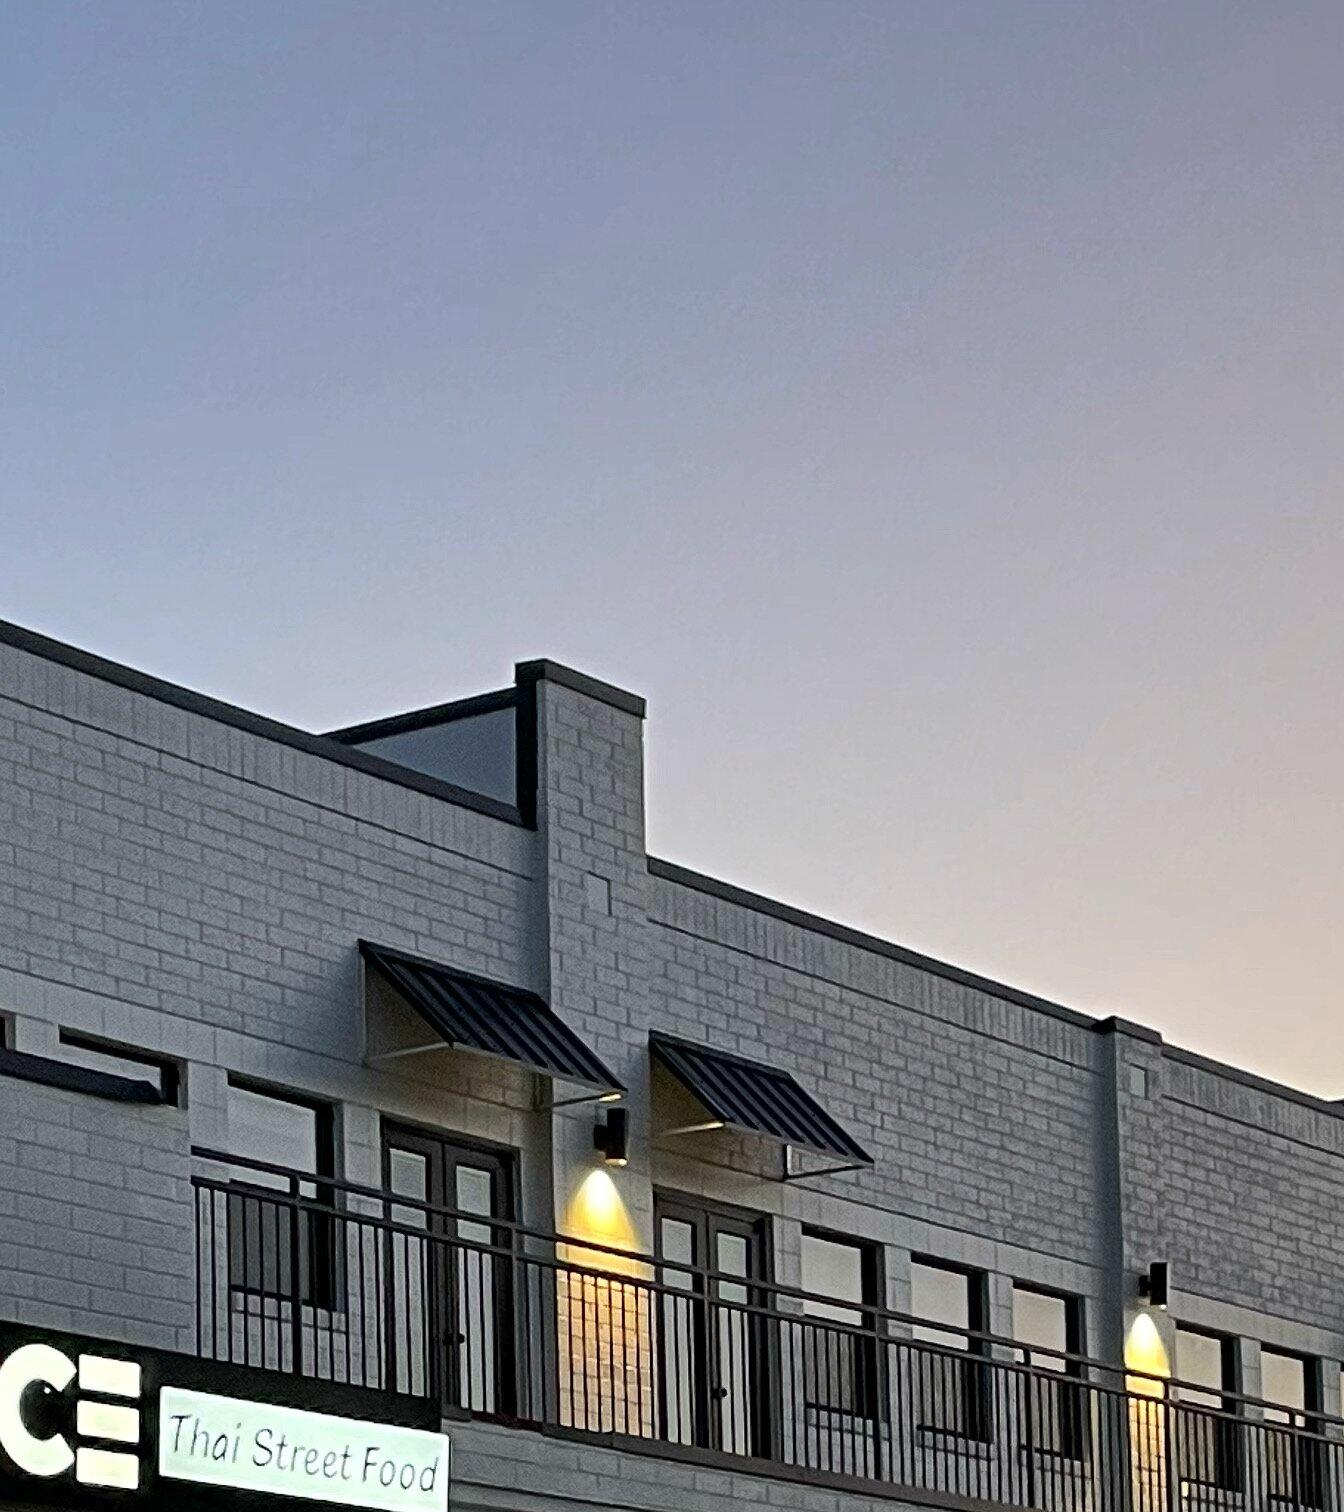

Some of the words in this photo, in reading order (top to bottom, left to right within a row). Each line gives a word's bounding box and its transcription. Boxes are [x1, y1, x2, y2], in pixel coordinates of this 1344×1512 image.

[169, 1414, 243, 1464] Thai
[251, 1428, 351, 1481] Street
[361, 1446, 439, 1493] Food
